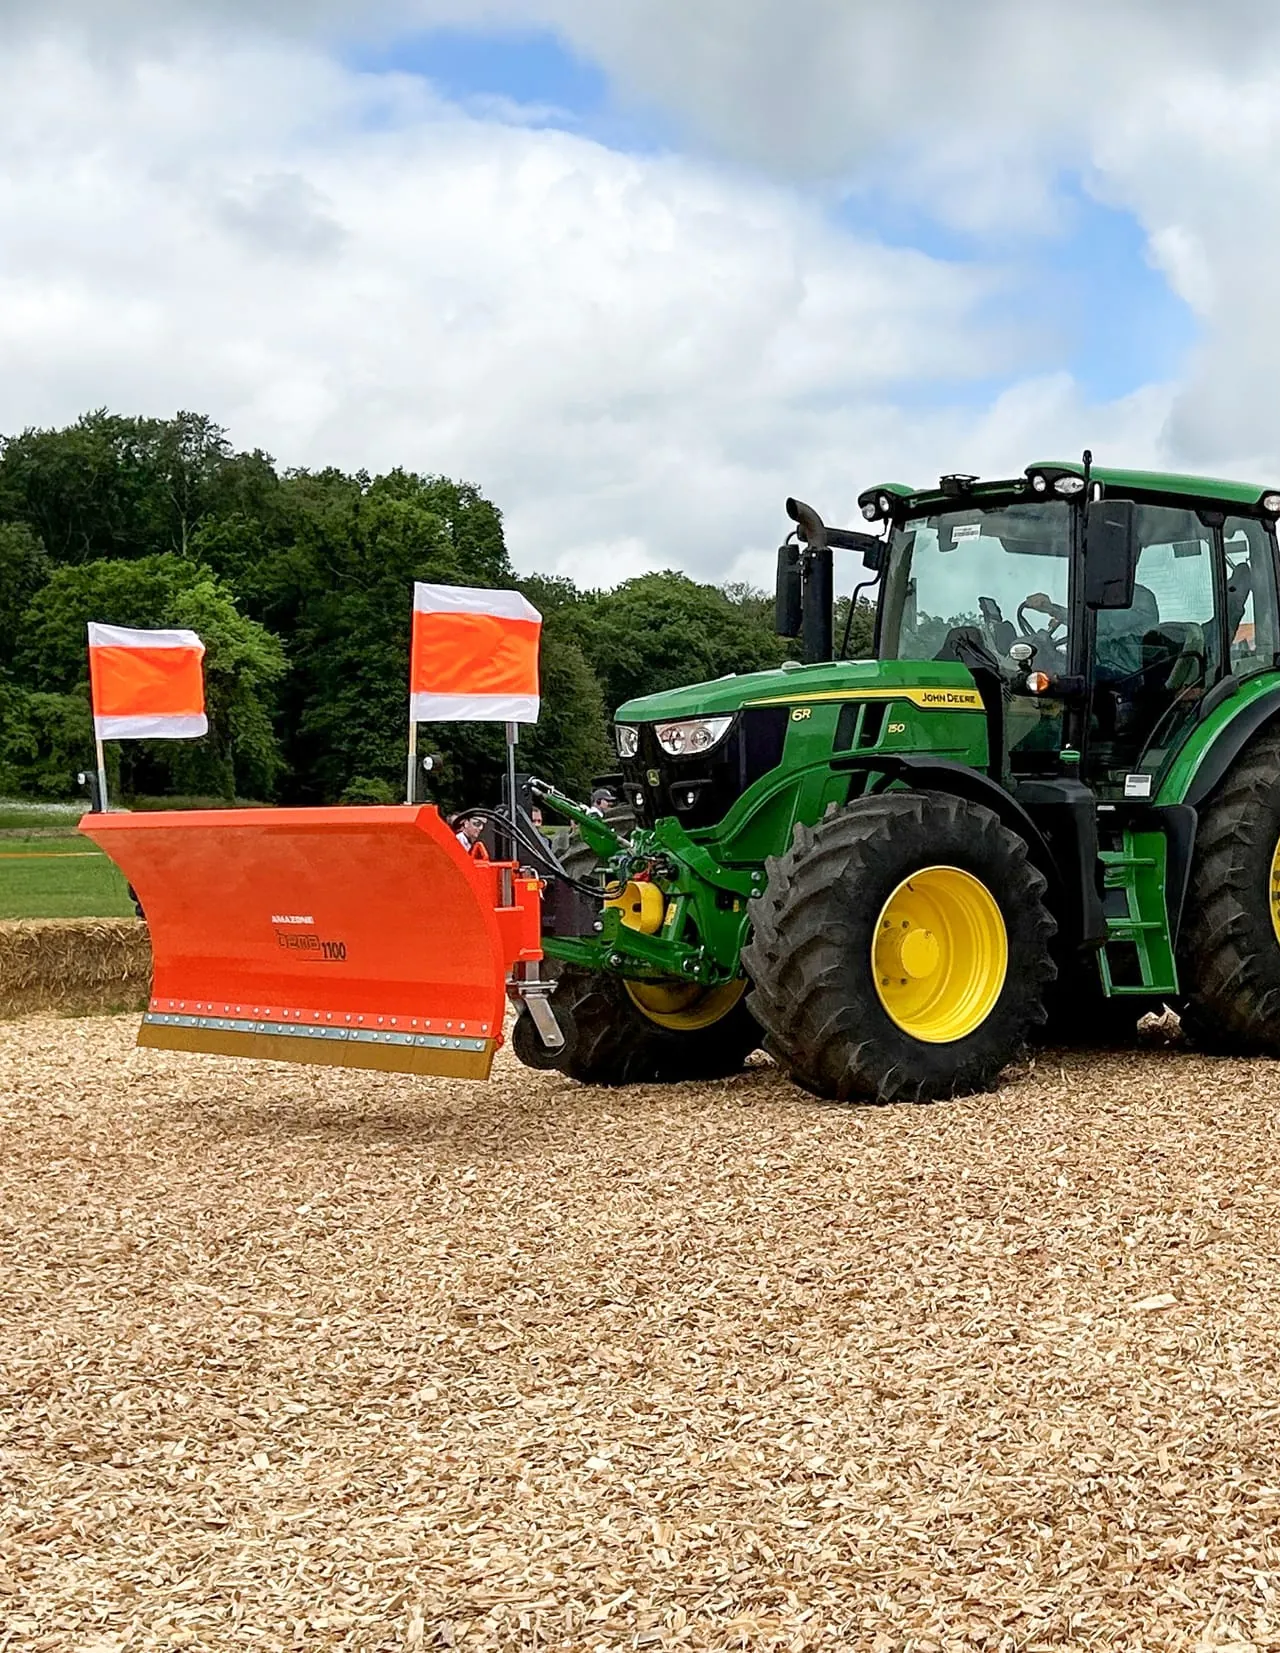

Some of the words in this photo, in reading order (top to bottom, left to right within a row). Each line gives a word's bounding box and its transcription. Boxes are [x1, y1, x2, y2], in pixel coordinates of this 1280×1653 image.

[922, 693, 946, 702] JOHN
[947, 693, 976, 703] DEERE
[791, 708, 811, 722] 6R
[887, 723, 905, 733] 150
[321, 942, 347, 960] 1100
